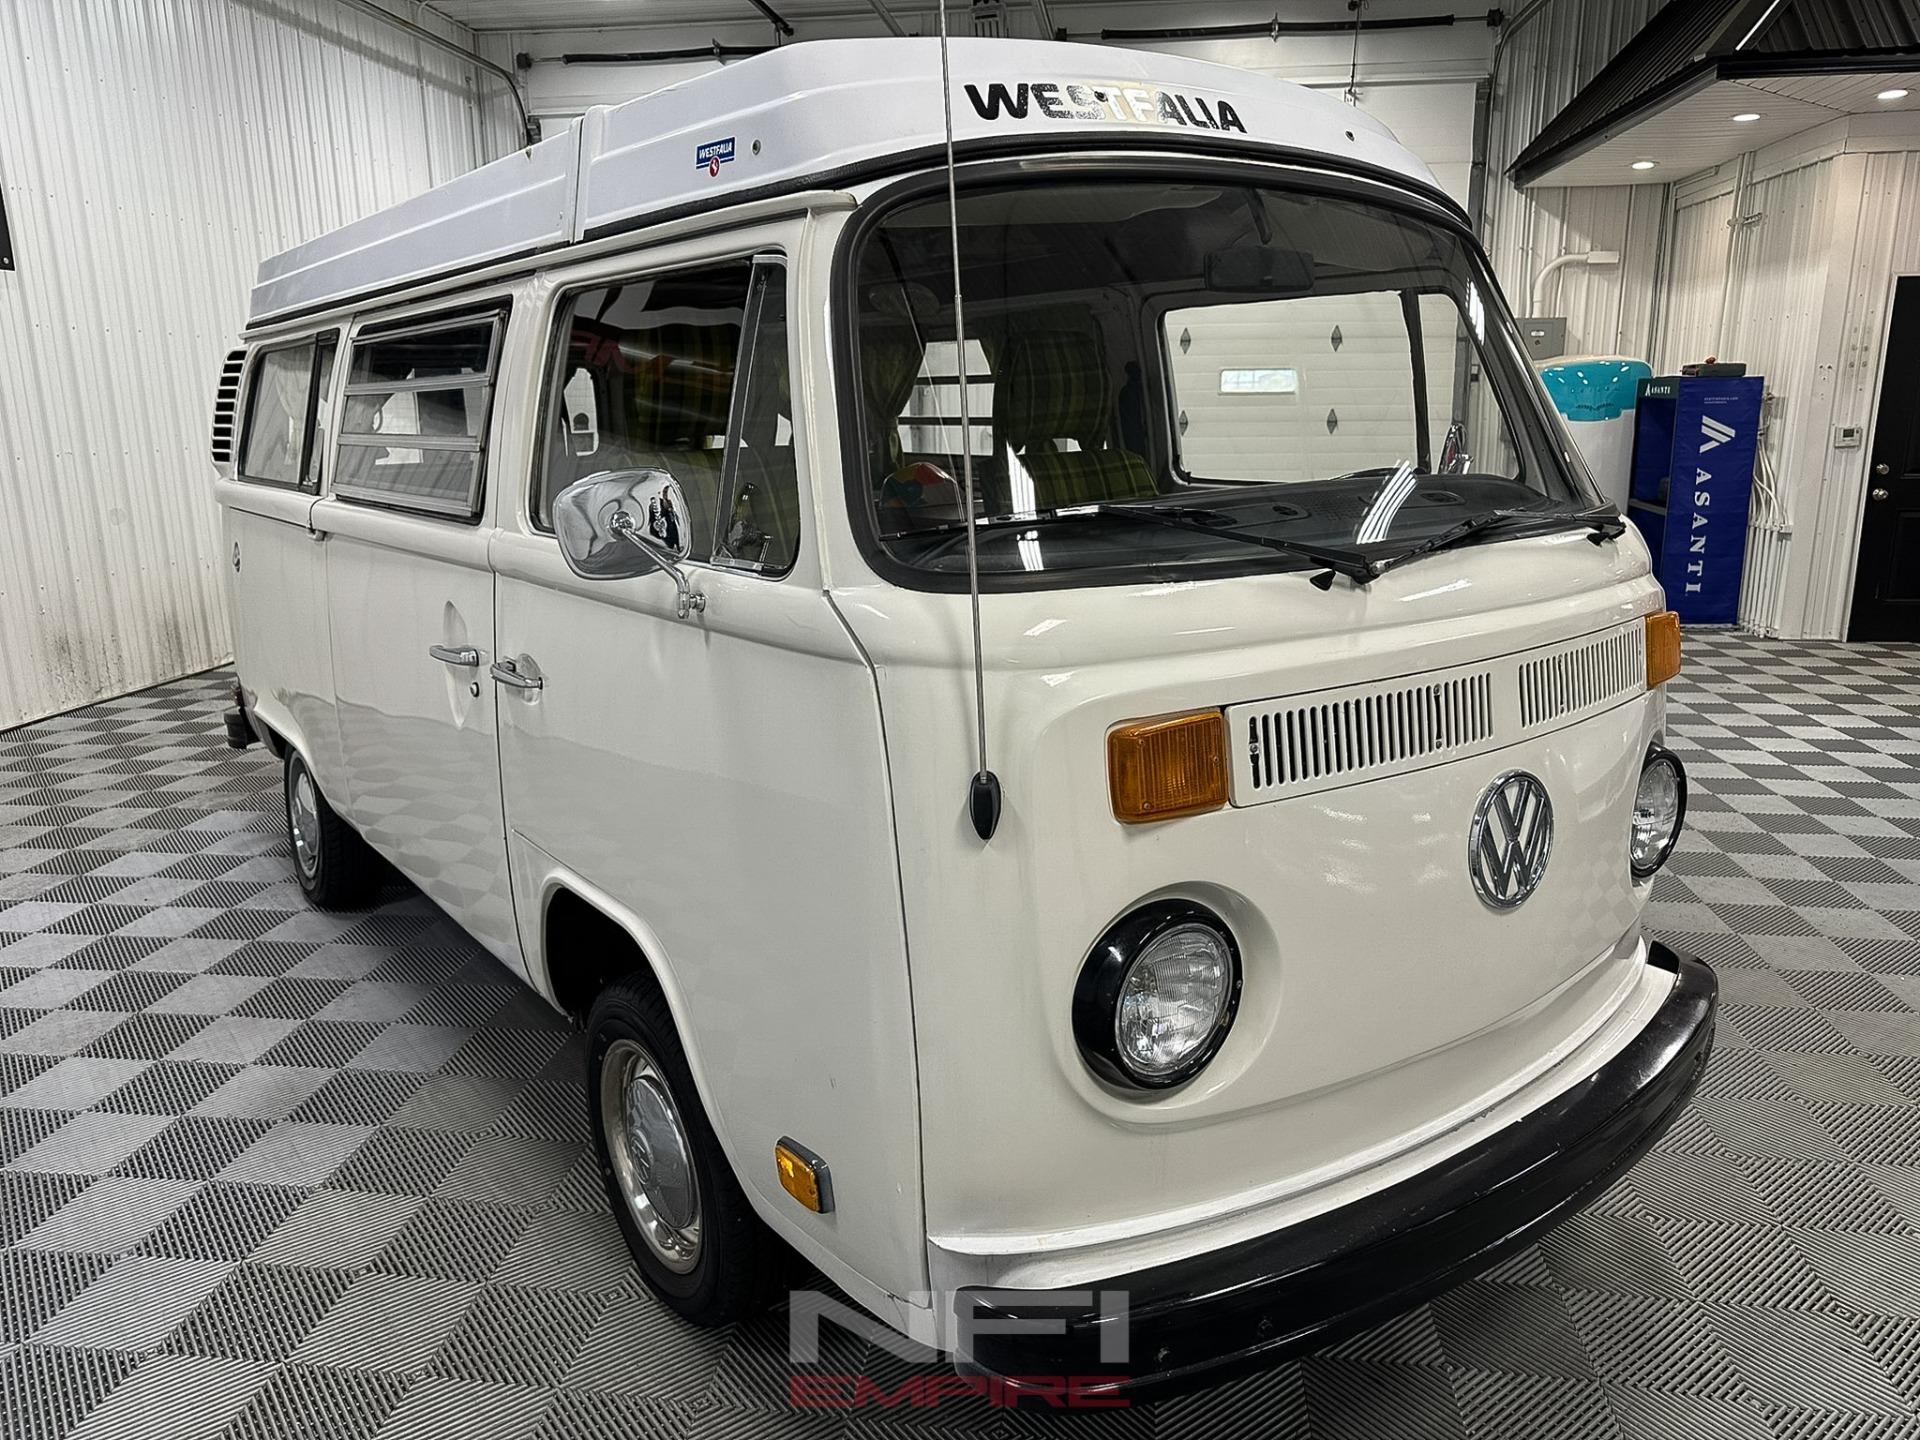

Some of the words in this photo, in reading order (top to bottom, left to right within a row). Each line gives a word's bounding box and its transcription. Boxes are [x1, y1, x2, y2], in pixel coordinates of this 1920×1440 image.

[699, 141, 732, 159] WESTFALIA
[964, 83, 1248, 134] WESTFALIA
[1685, 467, 1712, 592] ASANTI
[1479, 778, 1550, 903] VW
